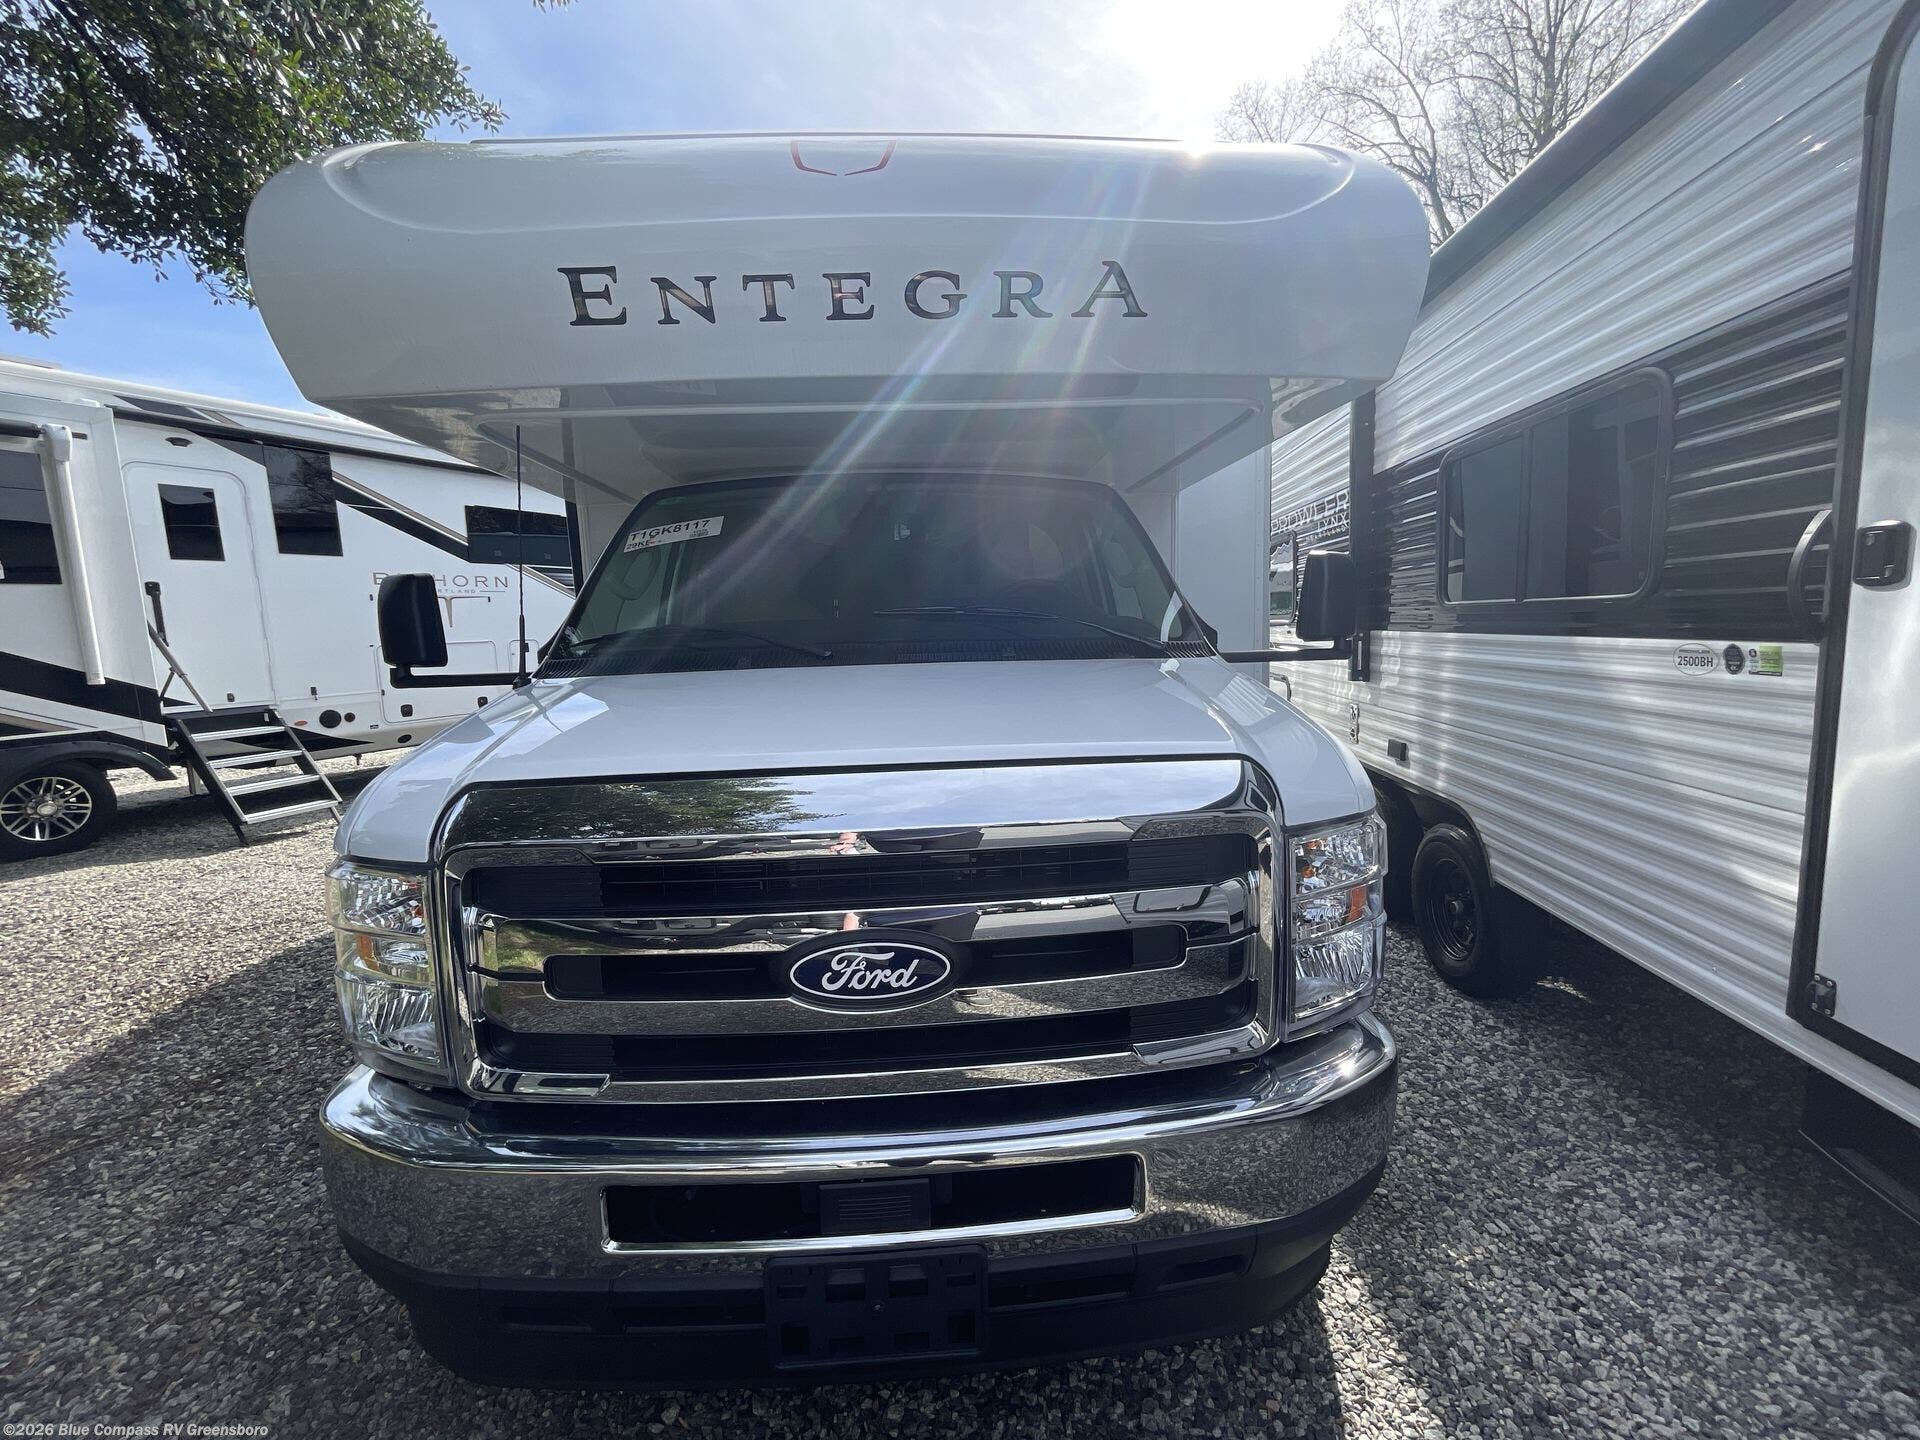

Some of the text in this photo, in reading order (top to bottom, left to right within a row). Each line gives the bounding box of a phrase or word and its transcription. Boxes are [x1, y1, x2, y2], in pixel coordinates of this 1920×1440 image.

[557, 260, 1149, 327] ENTEGRA
[630, 519, 711, 541] T1GK8117
[373, 571, 509, 588] BHORN
[1677, 655, 1714, 668] 2500BH
[821, 951, 920, 991] Ford
